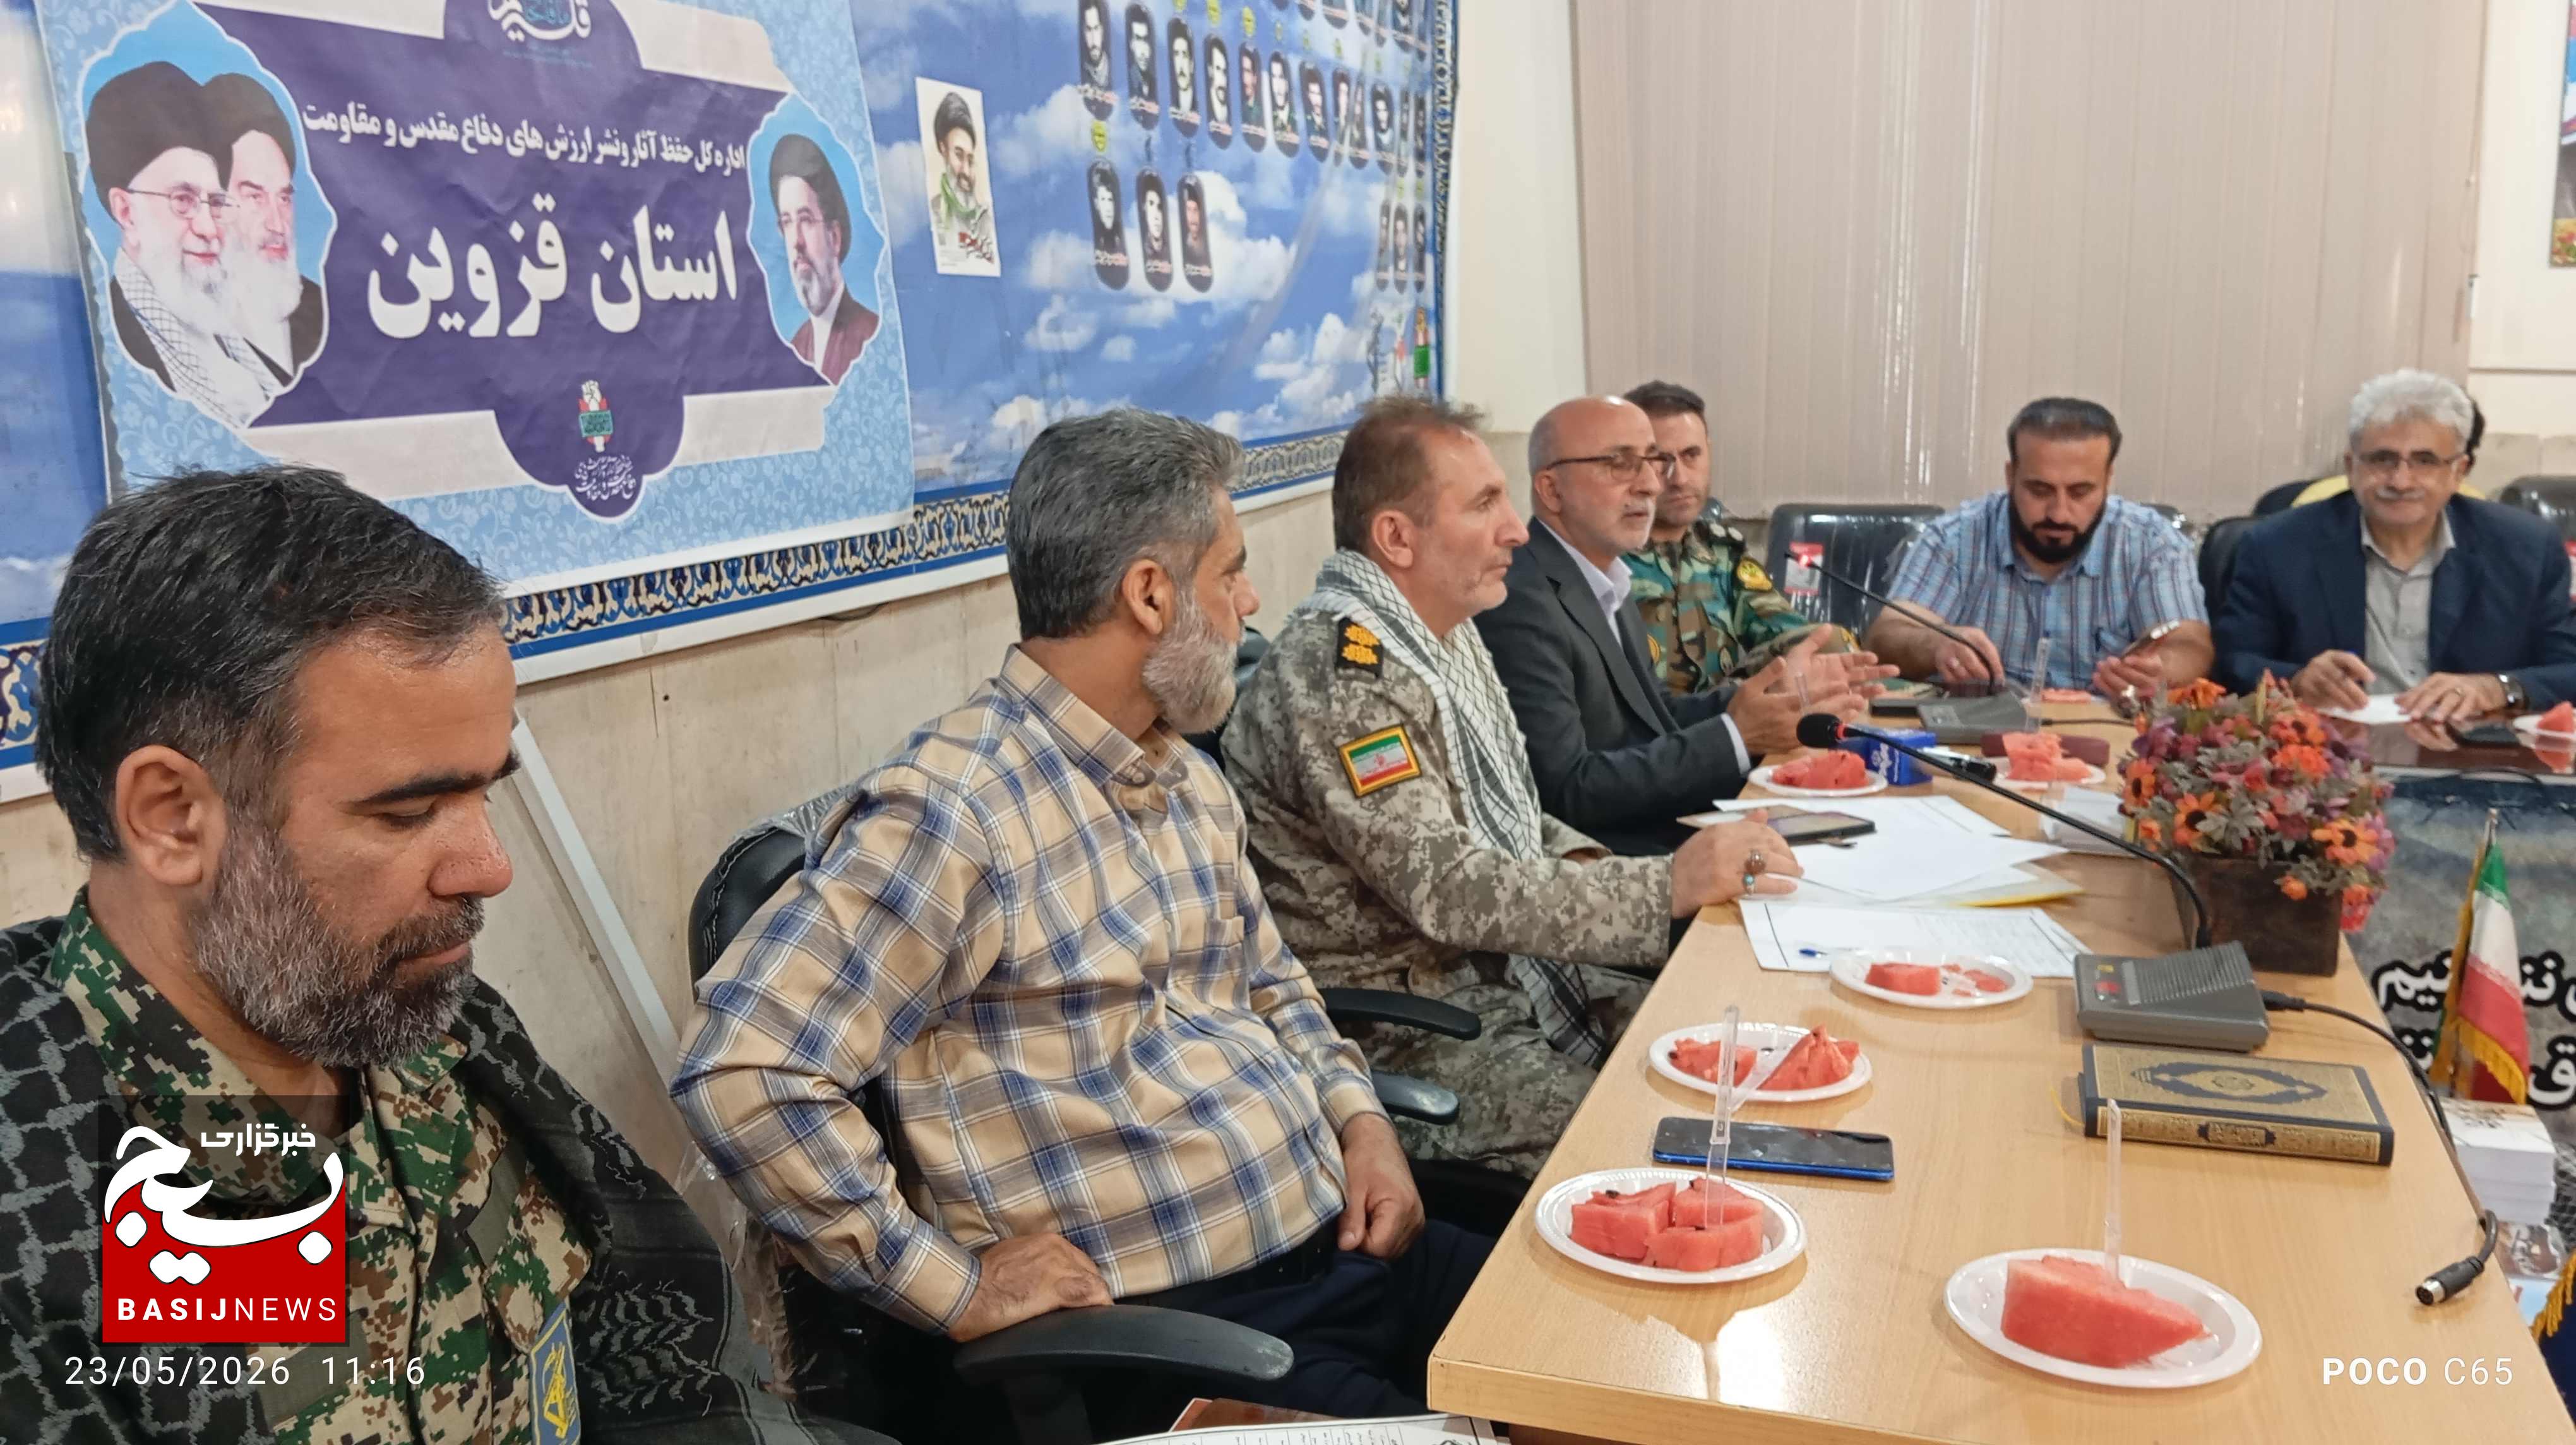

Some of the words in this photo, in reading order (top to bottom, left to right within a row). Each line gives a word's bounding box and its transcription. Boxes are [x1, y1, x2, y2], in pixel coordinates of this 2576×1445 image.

[302, 101, 380, 144] مقاومت
[383, 117, 397, 147] و
[399, 111, 460, 148] مقدس
[461, 112, 504, 155] دفاع
[506, 119, 543, 157] های
[546, 123, 592, 164] ارزش
[660, 134, 694, 163] حفظ
[695, 140, 713, 172] کل
[714, 142, 746, 177] اداره
[367, 193, 567, 339] قزوین
[591, 203, 737, 333] استان
